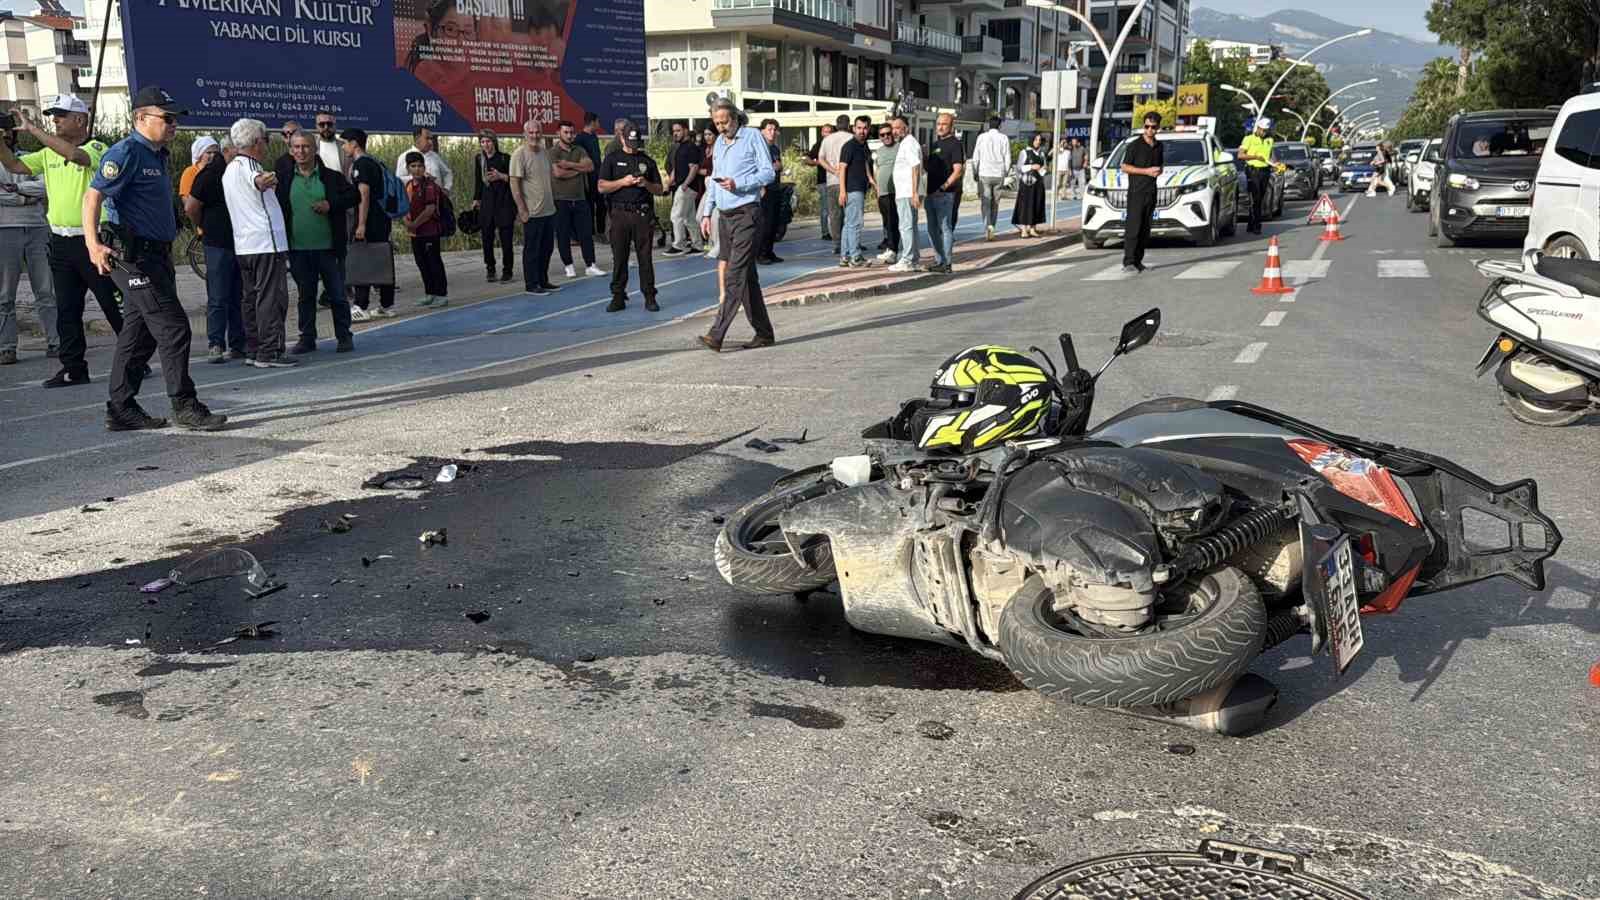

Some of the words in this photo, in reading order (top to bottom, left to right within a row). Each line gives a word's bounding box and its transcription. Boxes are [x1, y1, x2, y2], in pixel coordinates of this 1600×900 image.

[456, 0, 510, 20] BAŞLADI
[210, 20, 281, 41] YABANCI
[284, 23, 310, 44] DİL
[313, 29, 361, 48] KURSU
[474, 87, 504, 105] HAFTA
[507, 86, 520, 106] İÇİ
[526, 90, 552, 106] 08:30
[405, 98, 425, 113] 7-14
[427, 100, 442, 115] YAŞ
[476, 106, 496, 122] HER
[497, 104, 517, 123] GÜN
[527, 107, 552, 124] 12:30
[412, 112, 437, 127] ARASI
[1020, 388, 1039, 405] EVO
[1338, 546, 1352, 590] 33
